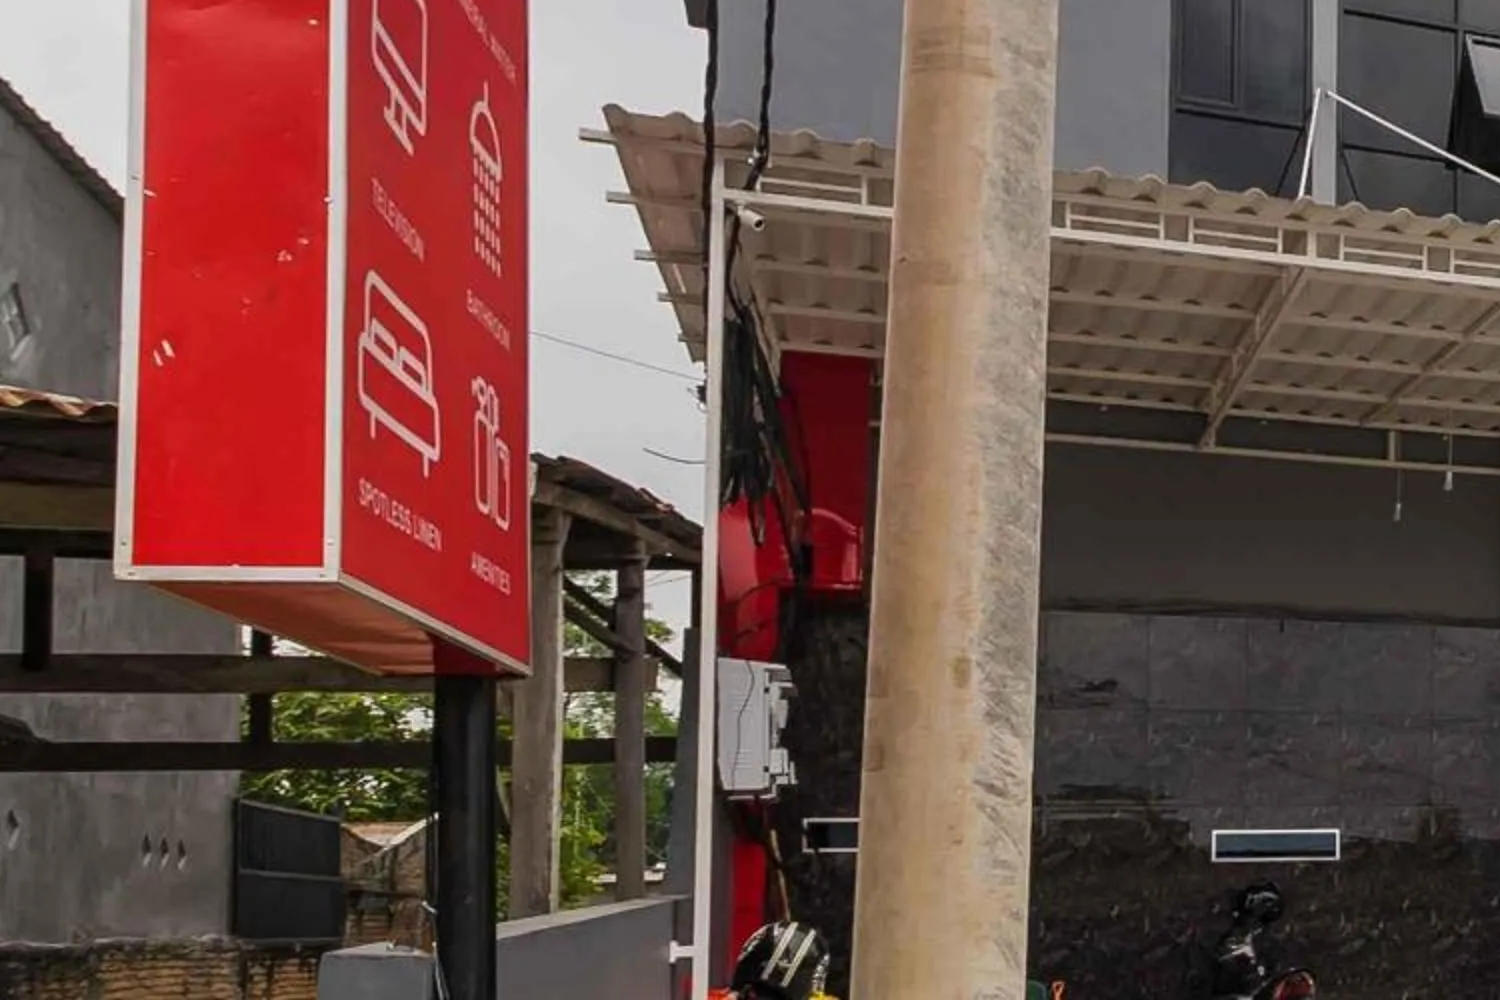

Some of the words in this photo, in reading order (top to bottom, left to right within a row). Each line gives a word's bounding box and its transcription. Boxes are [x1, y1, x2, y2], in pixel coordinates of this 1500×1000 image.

[371, 176, 425, 263] TELEVISION
[358, 477, 412, 535] SPOTLESS
[413, 514, 442, 552] LINEN
